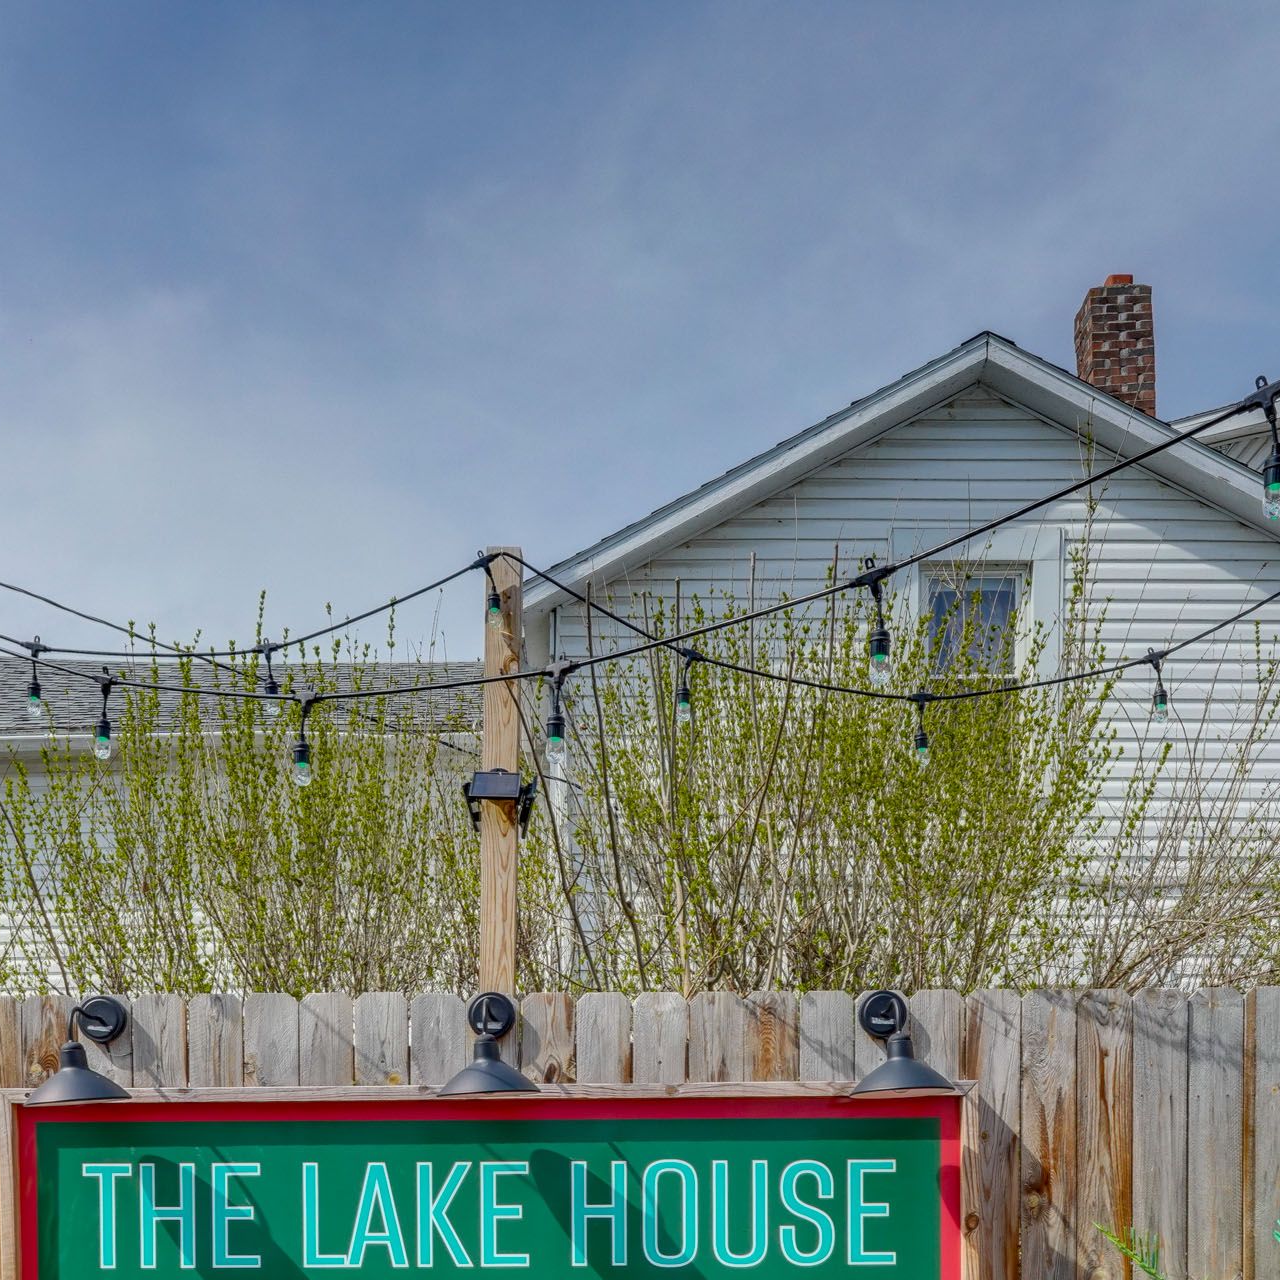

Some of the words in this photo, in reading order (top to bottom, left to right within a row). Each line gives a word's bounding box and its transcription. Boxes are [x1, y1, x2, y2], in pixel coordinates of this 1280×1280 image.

[81, 1162, 261, 1269] THE
[302, 1161, 530, 1268] LAKE
[570, 1158, 897, 1268] HOUSE
